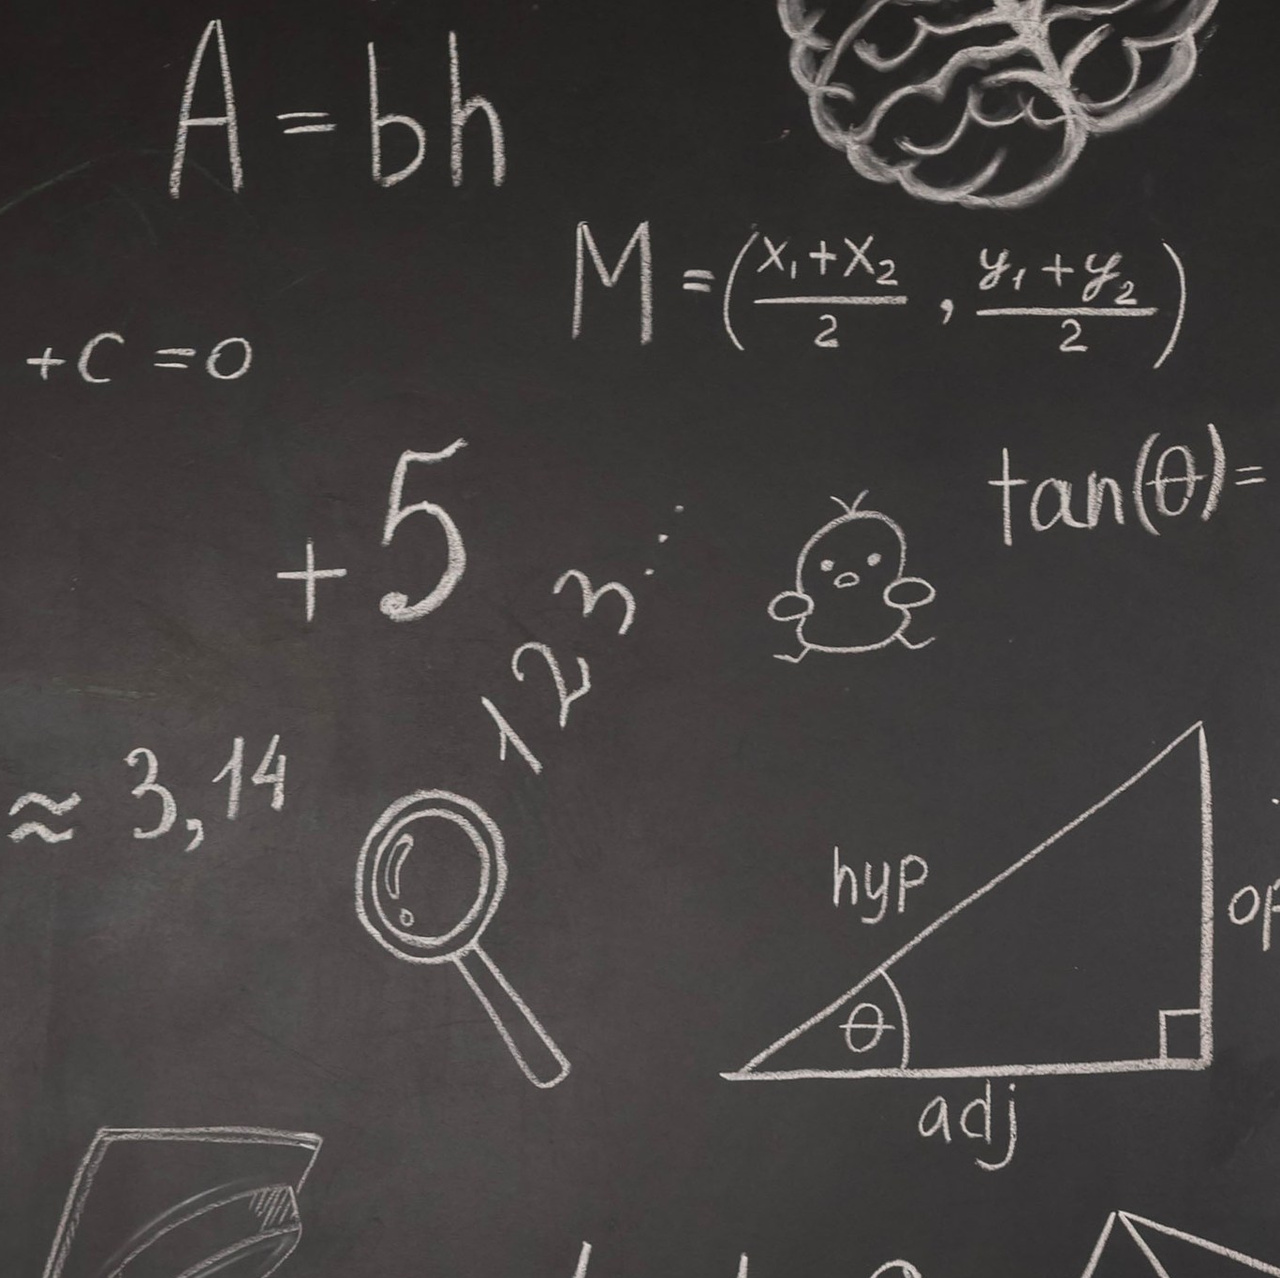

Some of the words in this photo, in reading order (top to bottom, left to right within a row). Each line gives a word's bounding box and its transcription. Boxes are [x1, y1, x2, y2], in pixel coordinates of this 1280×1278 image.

[170, 20, 242, 197] A
[124, 733, 287, 852] 3,14
[831, 844, 929, 926] hyp
[918, 1081, 1017, 1170] adj
